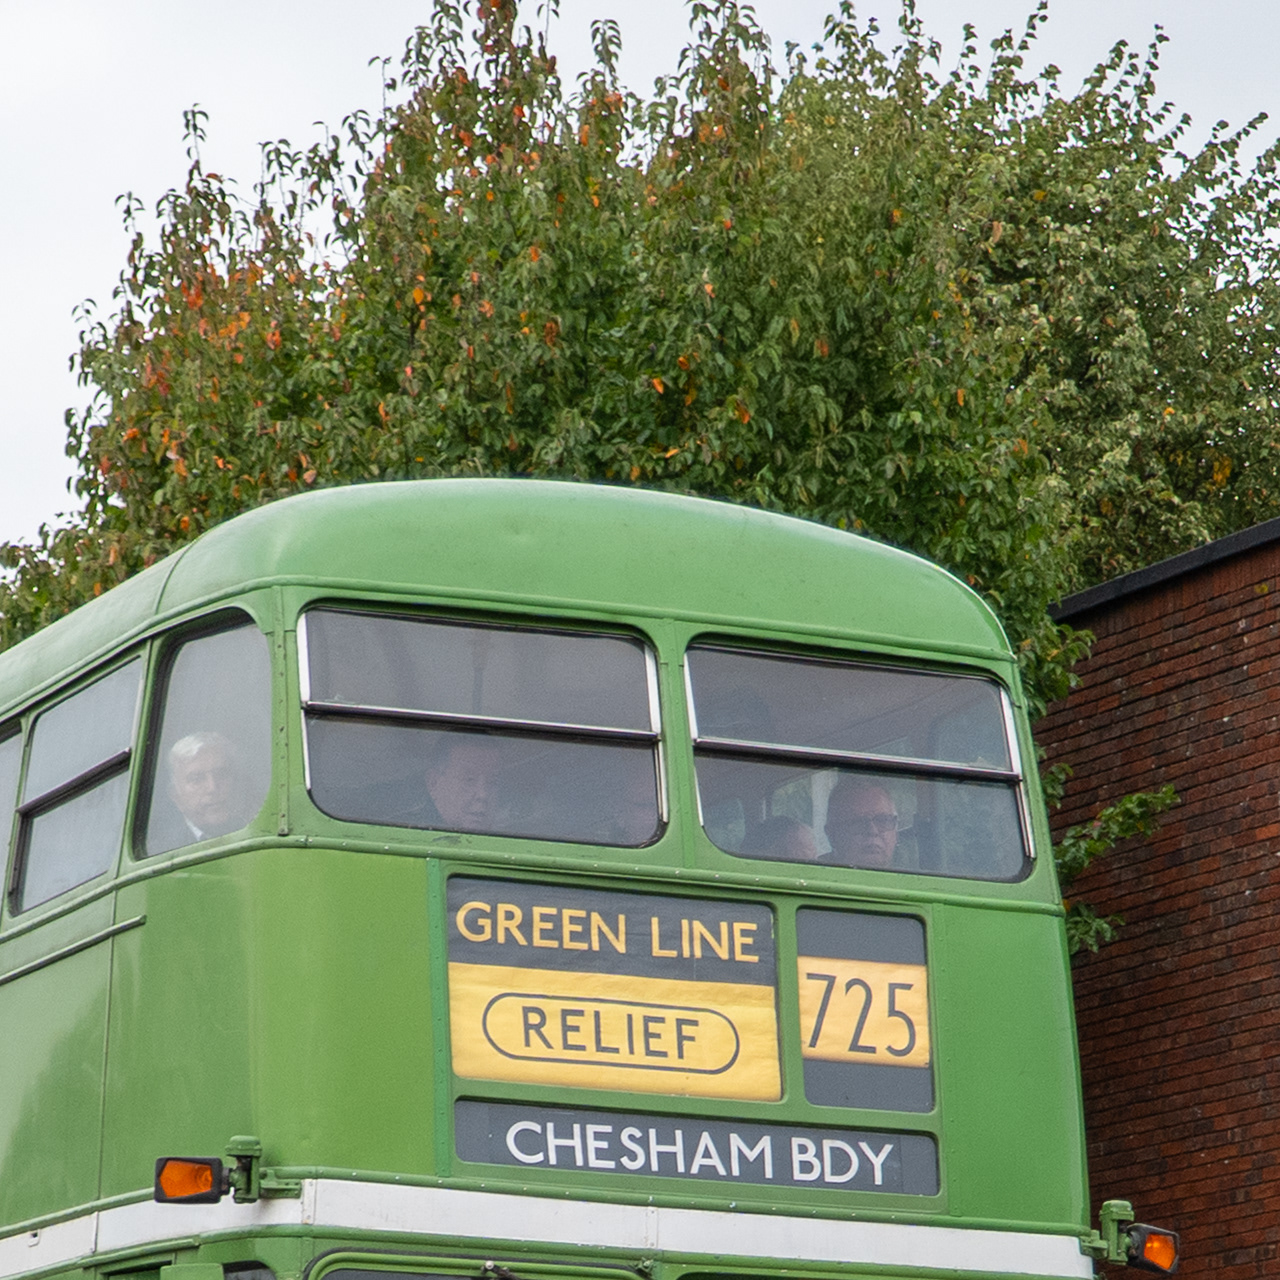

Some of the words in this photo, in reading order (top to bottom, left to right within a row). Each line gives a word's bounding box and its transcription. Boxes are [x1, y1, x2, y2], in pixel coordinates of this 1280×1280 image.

[455, 901, 626, 954] GREEN
[651, 917, 760, 963] LINE
[521, 1005, 700, 1060] RELIEF
[806, 972, 917, 1057] 725
[505, 1120, 774, 1180] CHESHAM
[791, 1137, 894, 1186] BDY
